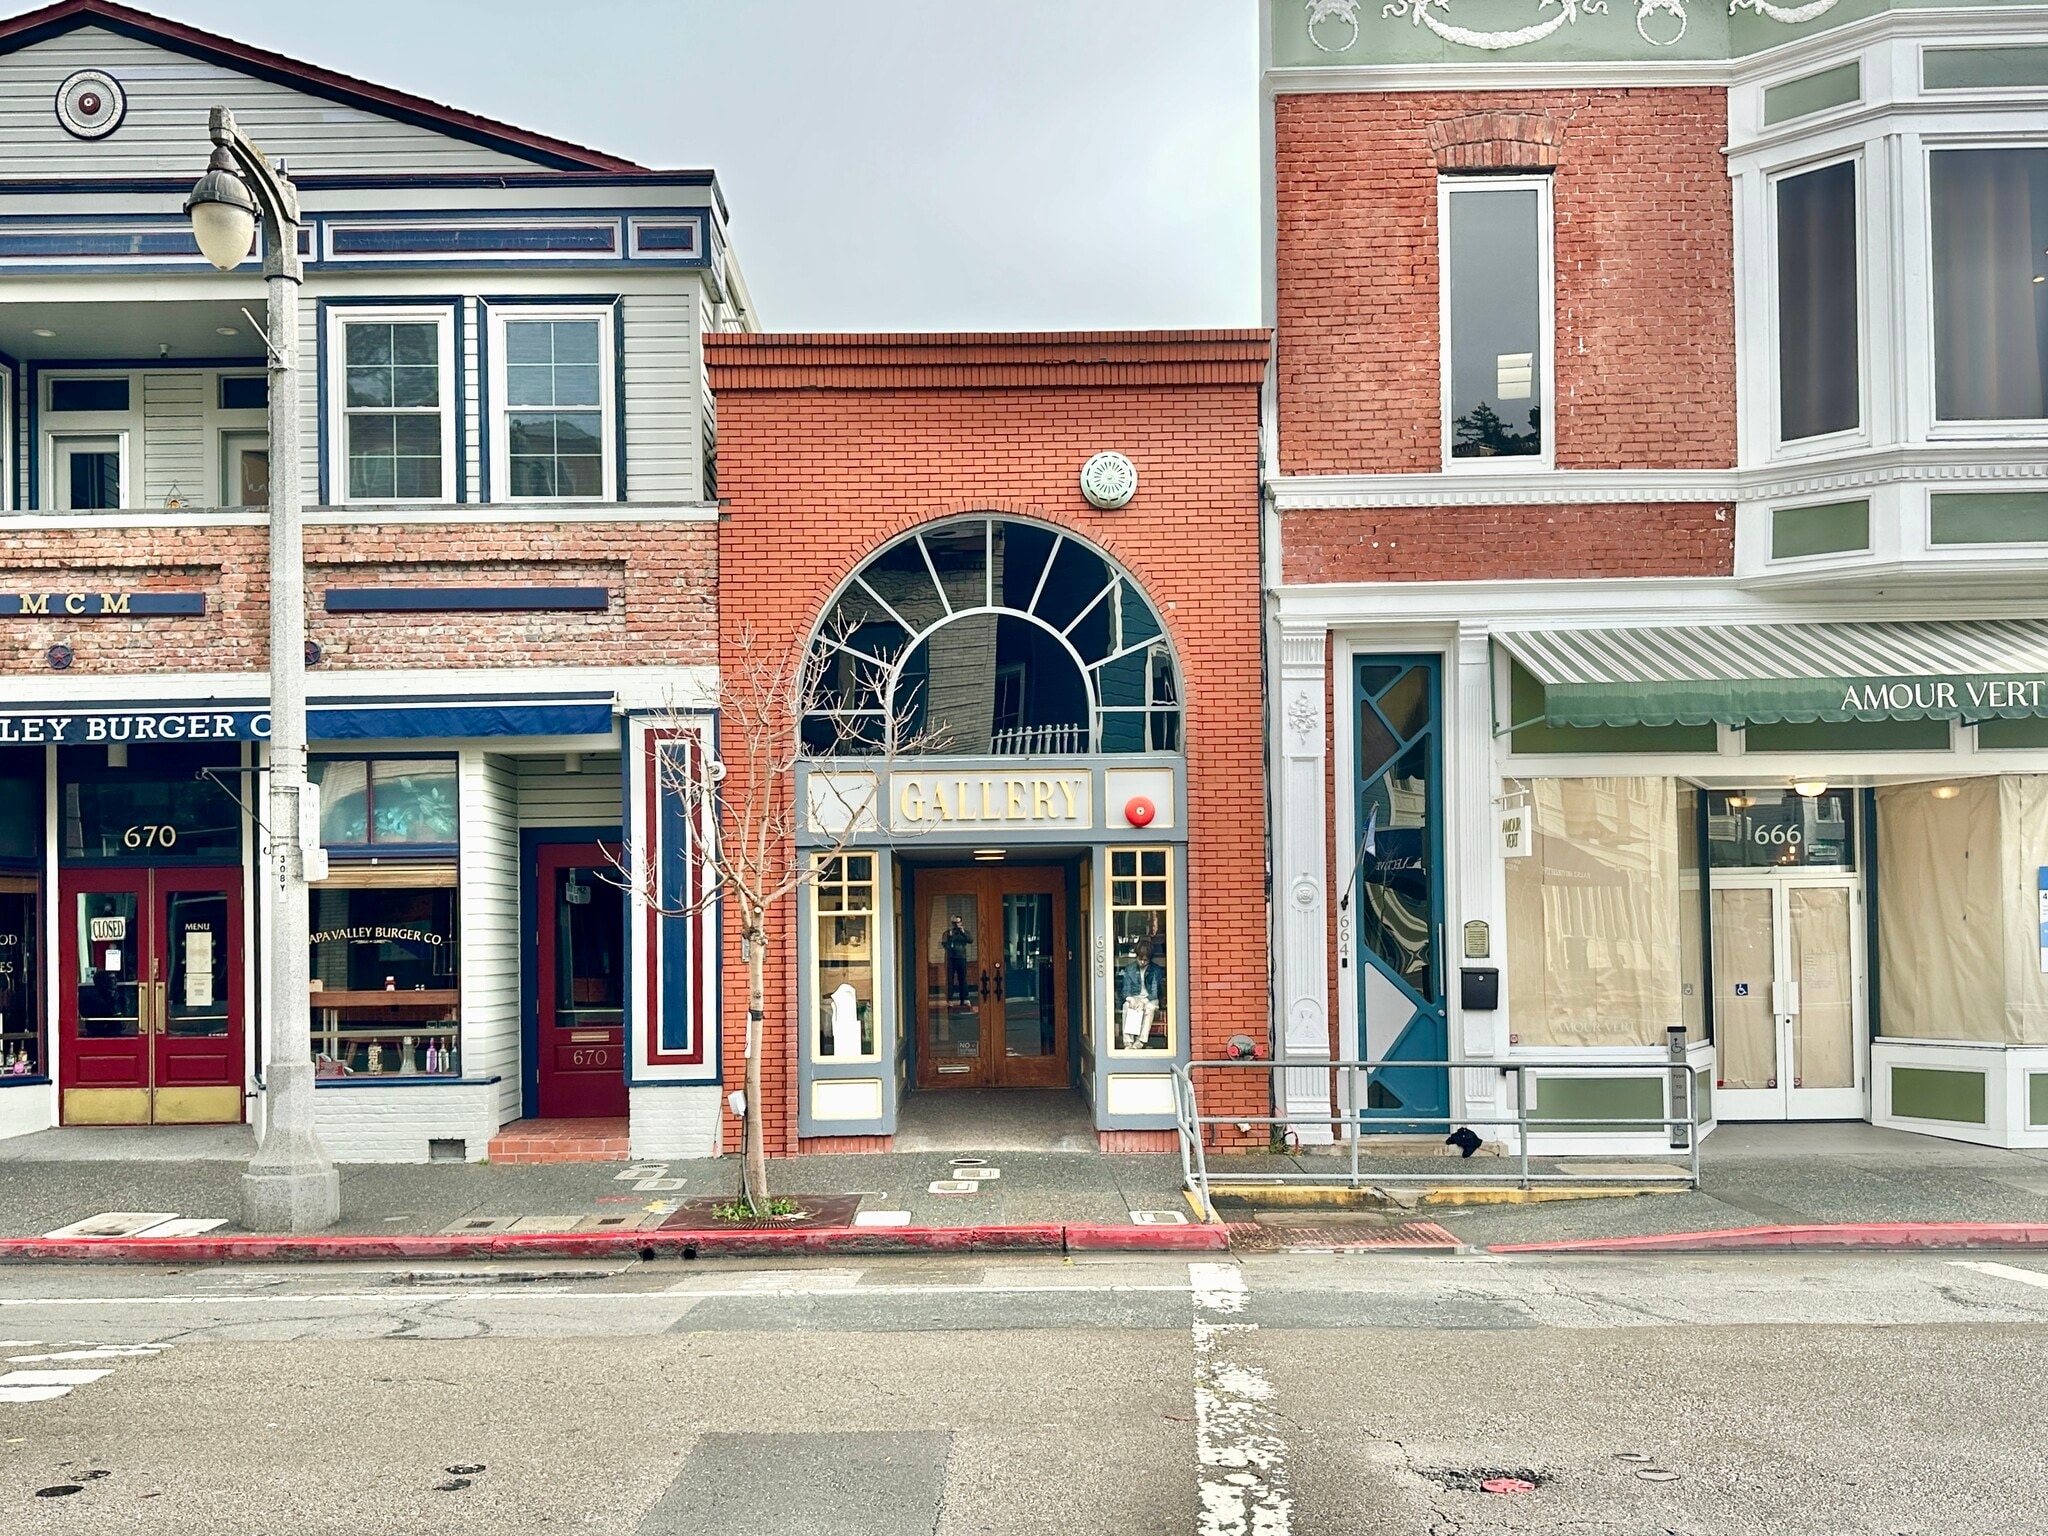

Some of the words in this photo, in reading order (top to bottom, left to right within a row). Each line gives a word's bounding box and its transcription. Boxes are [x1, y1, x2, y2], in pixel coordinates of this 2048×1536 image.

[1841, 682, 1958, 711] AMOUR
[1965, 681, 2046, 707] VERT
[85, 715, 236, 741] BURGER
[250, 715, 271, 736] C
[900, 780, 1083, 822] GALLERY
[1502, 817, 1521, 833] AMOUR
[1754, 823, 1802, 845] 666
[123, 825, 177, 848] 670
[93, 920, 124, 938] CLOSED
[184, 923, 210, 931] MENU
[309, 931, 331, 944] APA
[330, 927, 372, 940] VALLEY
[375, 927, 421, 941] BURGER
[423, 932, 443, 946] CO.
[1340, 915, 1349, 956] 664
[1559, 1022, 1600, 1033] AMOUR
[1605, 1021, 1636, 1032] VERT
[573, 1050, 608, 1065] 670
